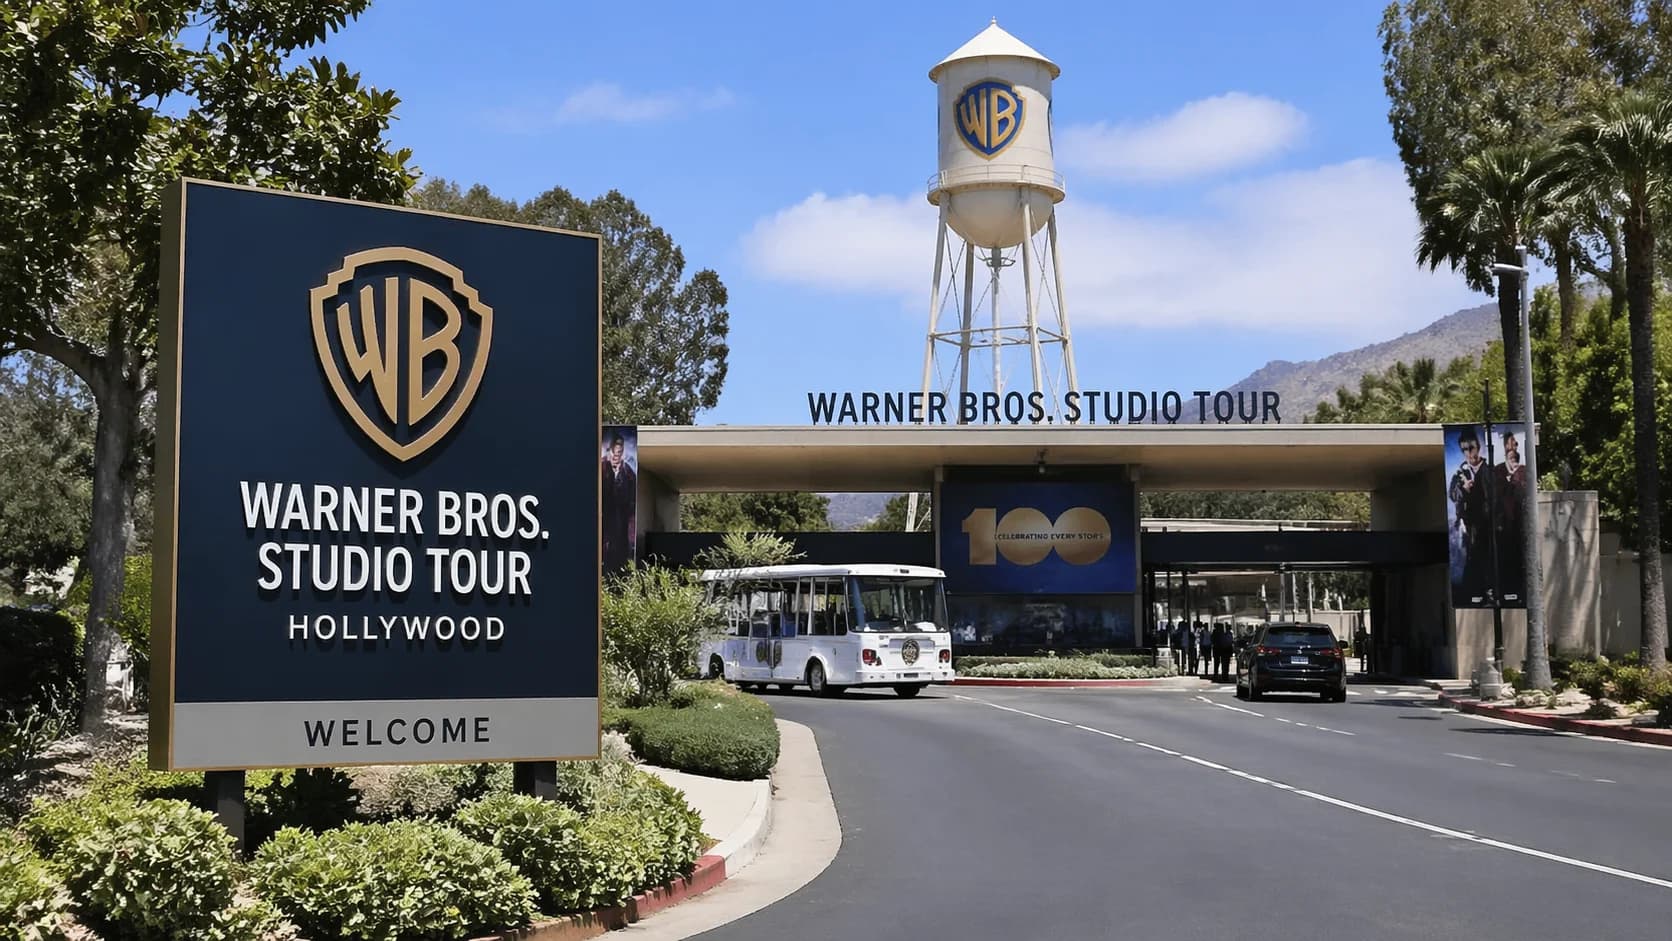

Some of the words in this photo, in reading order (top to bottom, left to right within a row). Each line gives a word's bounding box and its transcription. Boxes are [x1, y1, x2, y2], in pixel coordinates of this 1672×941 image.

[960, 88, 1017, 149] WB
[336, 276, 462, 427] WB
[807, 391, 948, 423] WARNER
[960, 391, 1055, 423] BROS.
[1064, 391, 1182, 423] STUDIO
[1193, 391, 1281, 423] TOUR
[240, 480, 424, 535] WARNER
[438, 490, 550, 540] BROS.
[962, 507, 1112, 567] 100
[257, 542, 413, 593] STUDIO
[426, 547, 532, 595] TOUR
[288, 614, 505, 641] HOLLYWOOD
[303, 716, 490, 747] WELCOME
